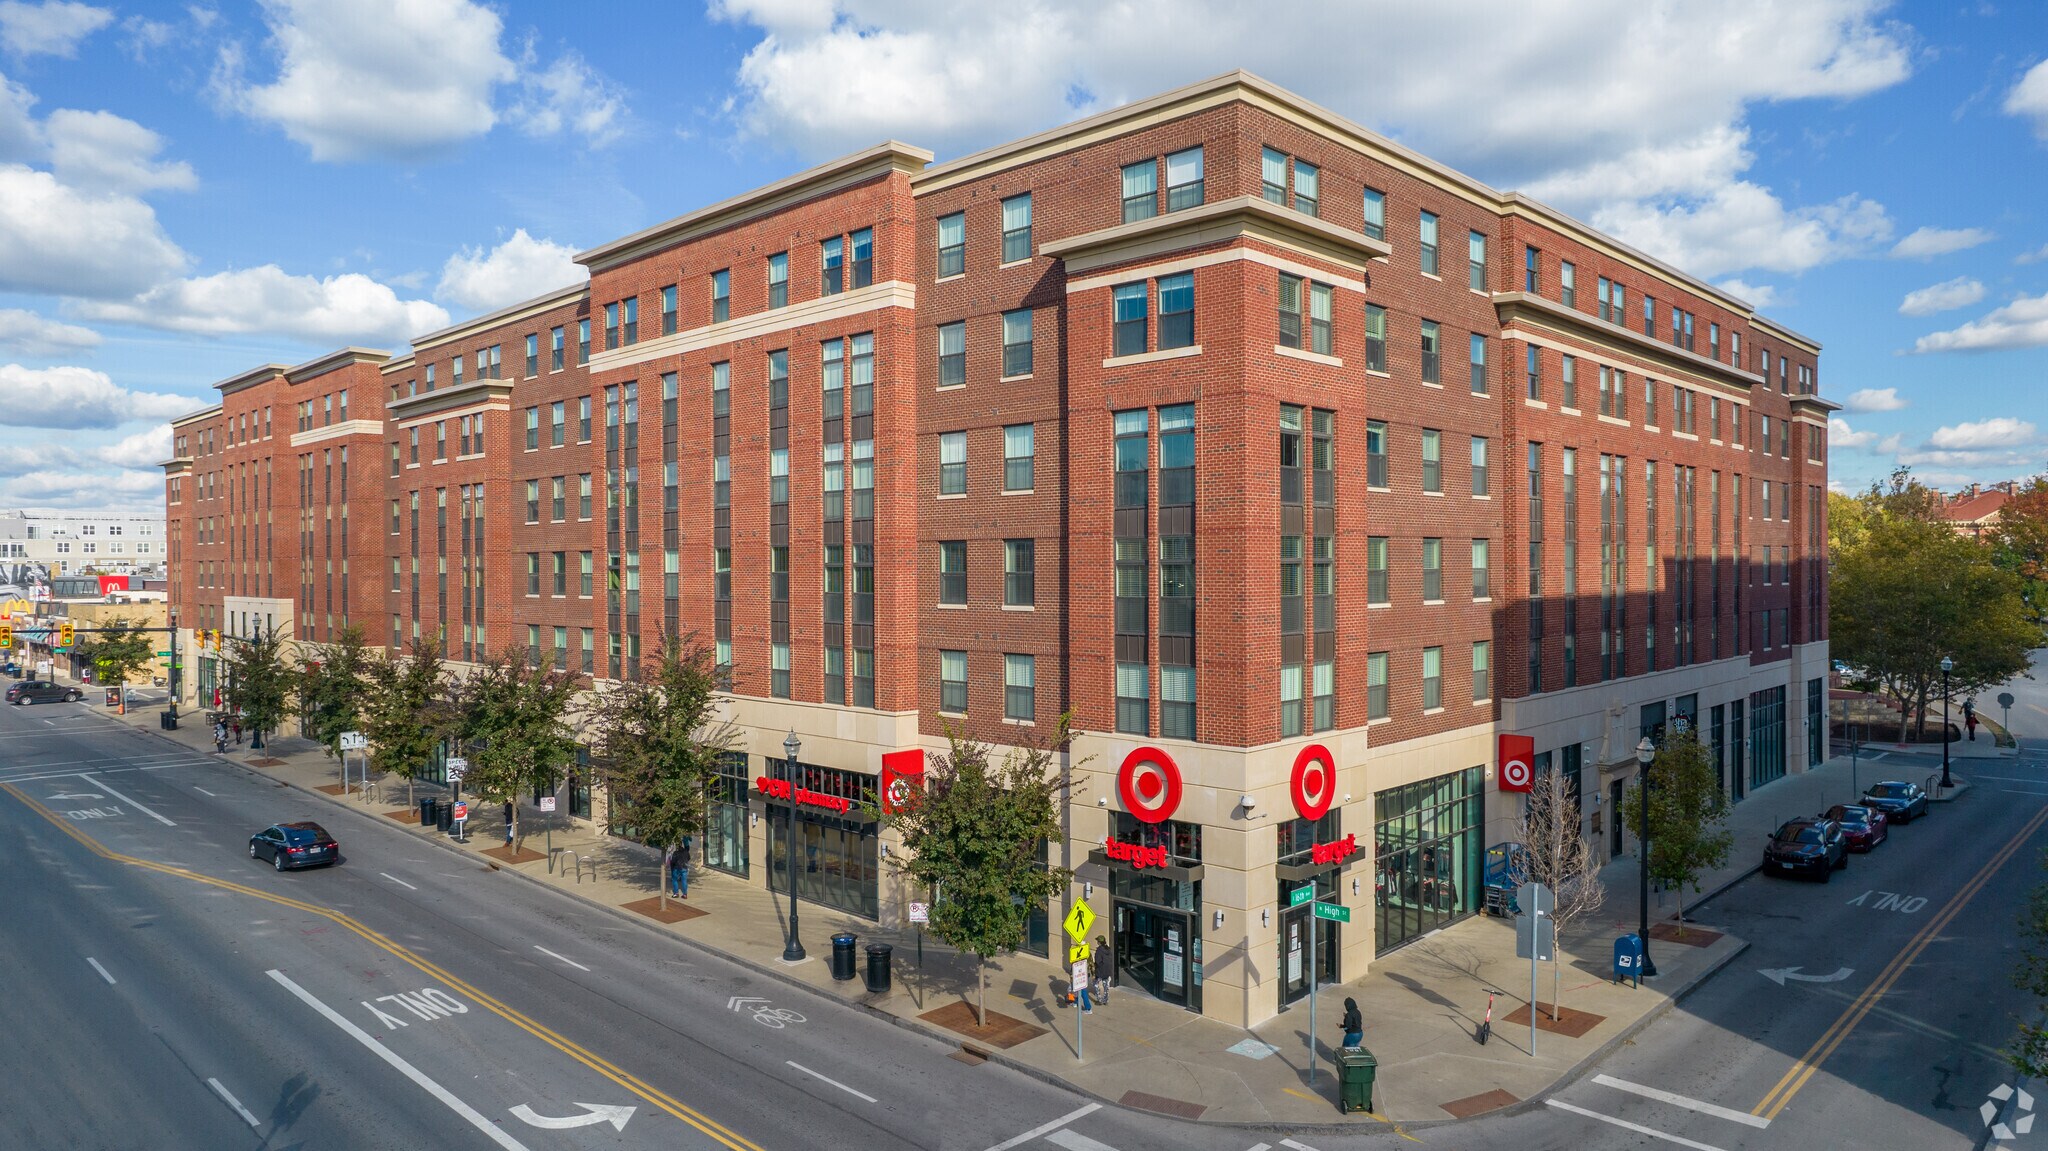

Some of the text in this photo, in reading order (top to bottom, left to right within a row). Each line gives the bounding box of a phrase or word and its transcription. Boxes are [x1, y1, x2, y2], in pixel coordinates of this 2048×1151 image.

[68, 806, 124, 820] ONLY
[1106, 836, 1169, 869] target
[1311, 833, 1357, 865] target
[1295, 892, 1304, 902] 16th
[1845, 890, 1928, 914] ONLY
[1324, 905, 1340, 917] High
[361, 988, 469, 1030] ONLY
